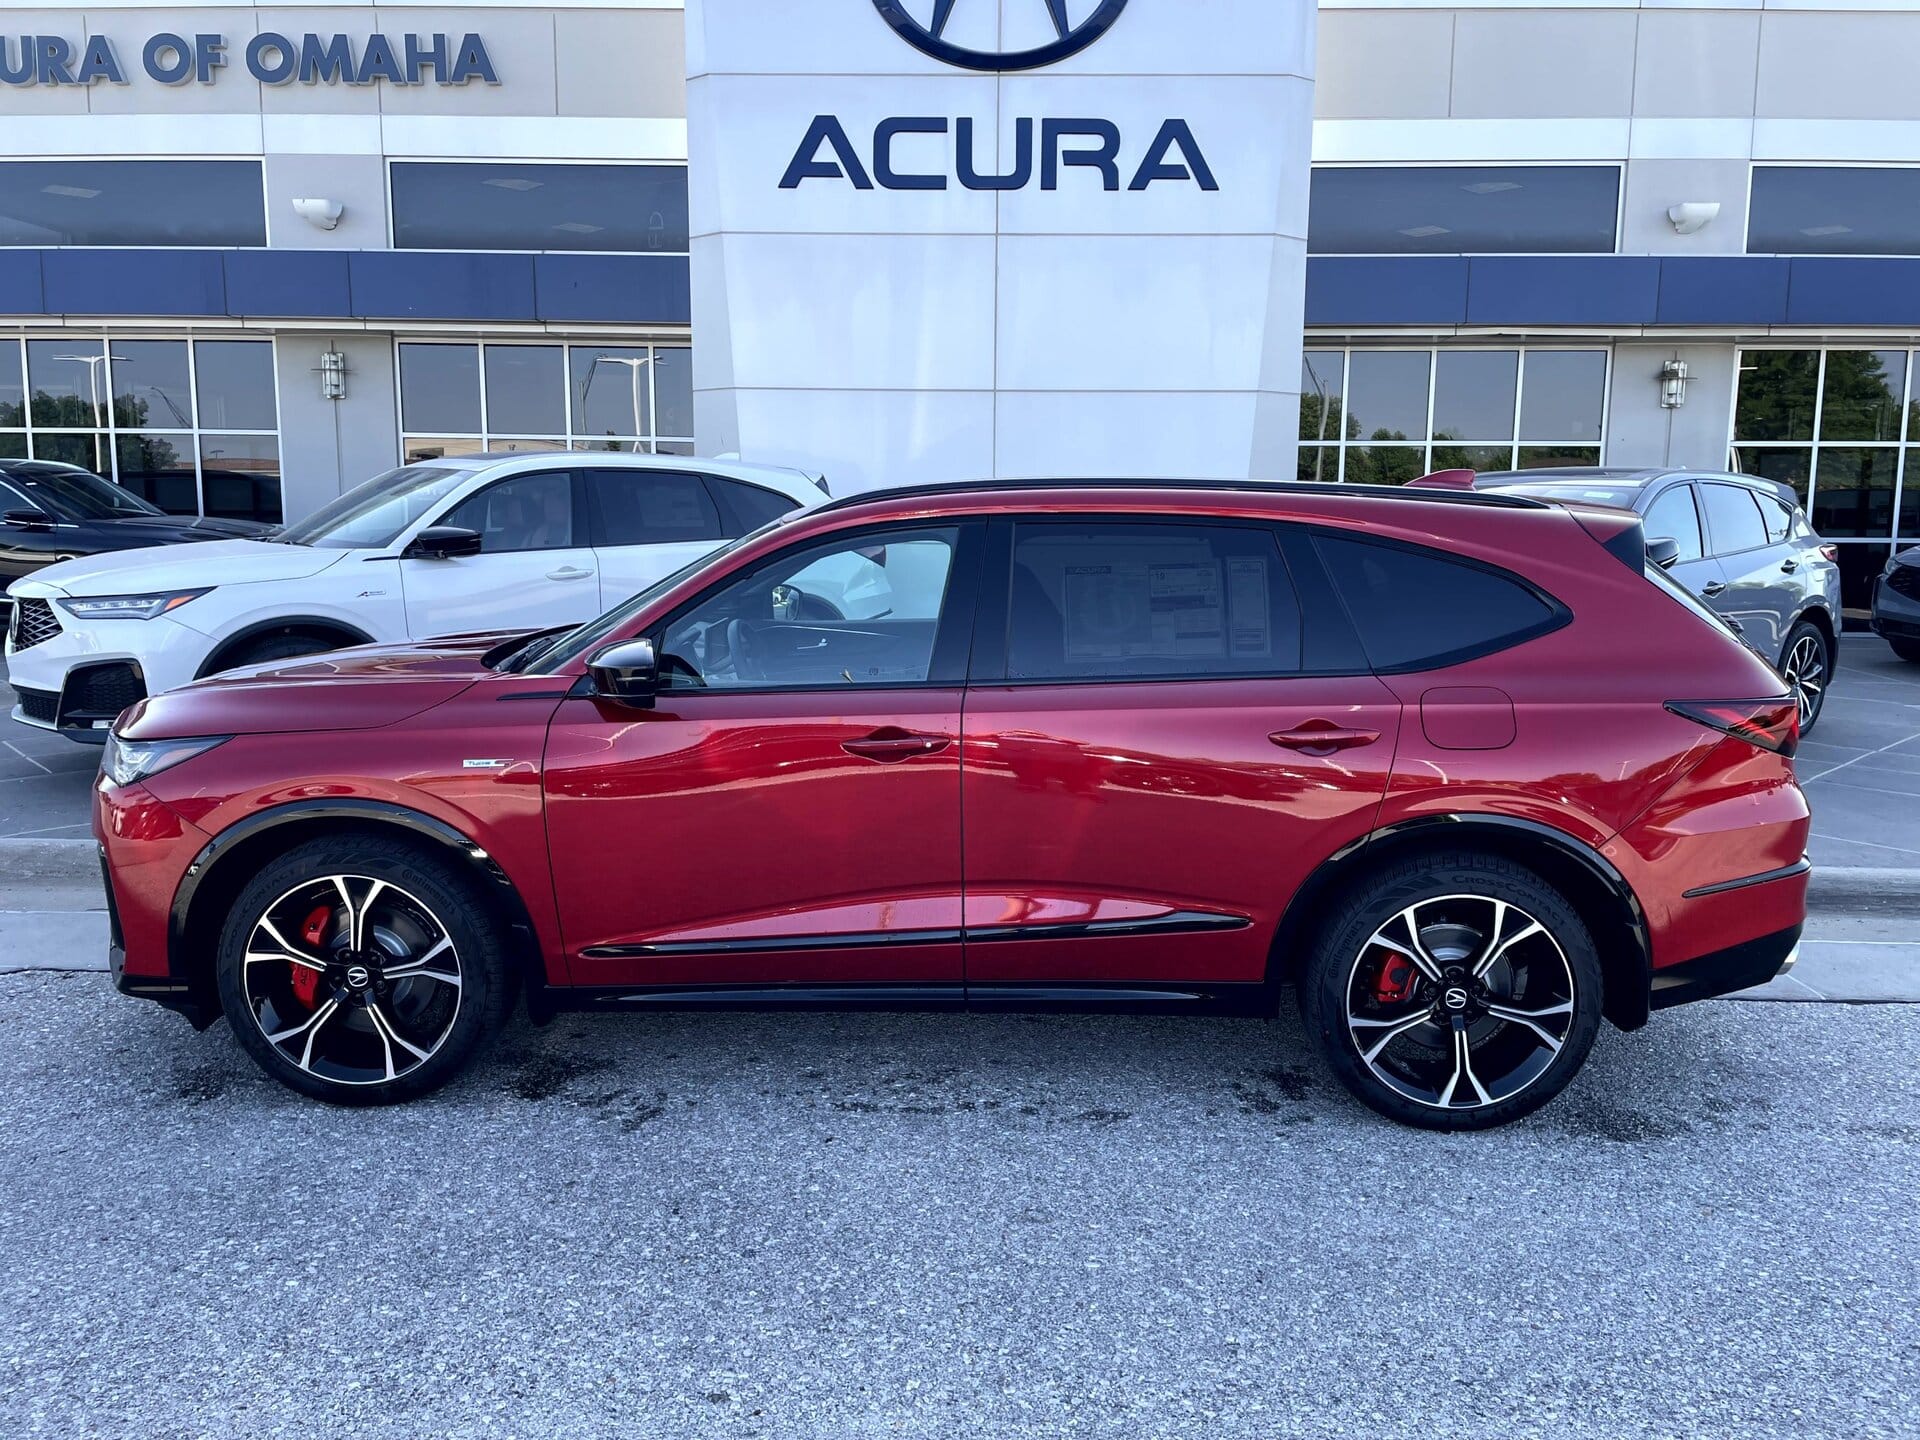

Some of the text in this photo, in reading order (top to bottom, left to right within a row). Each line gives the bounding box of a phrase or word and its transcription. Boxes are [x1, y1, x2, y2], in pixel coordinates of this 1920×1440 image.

[142, 33, 227, 84] OF
[245, 33, 499, 85] OMAHA
[778, 115, 1220, 191] ACURA
